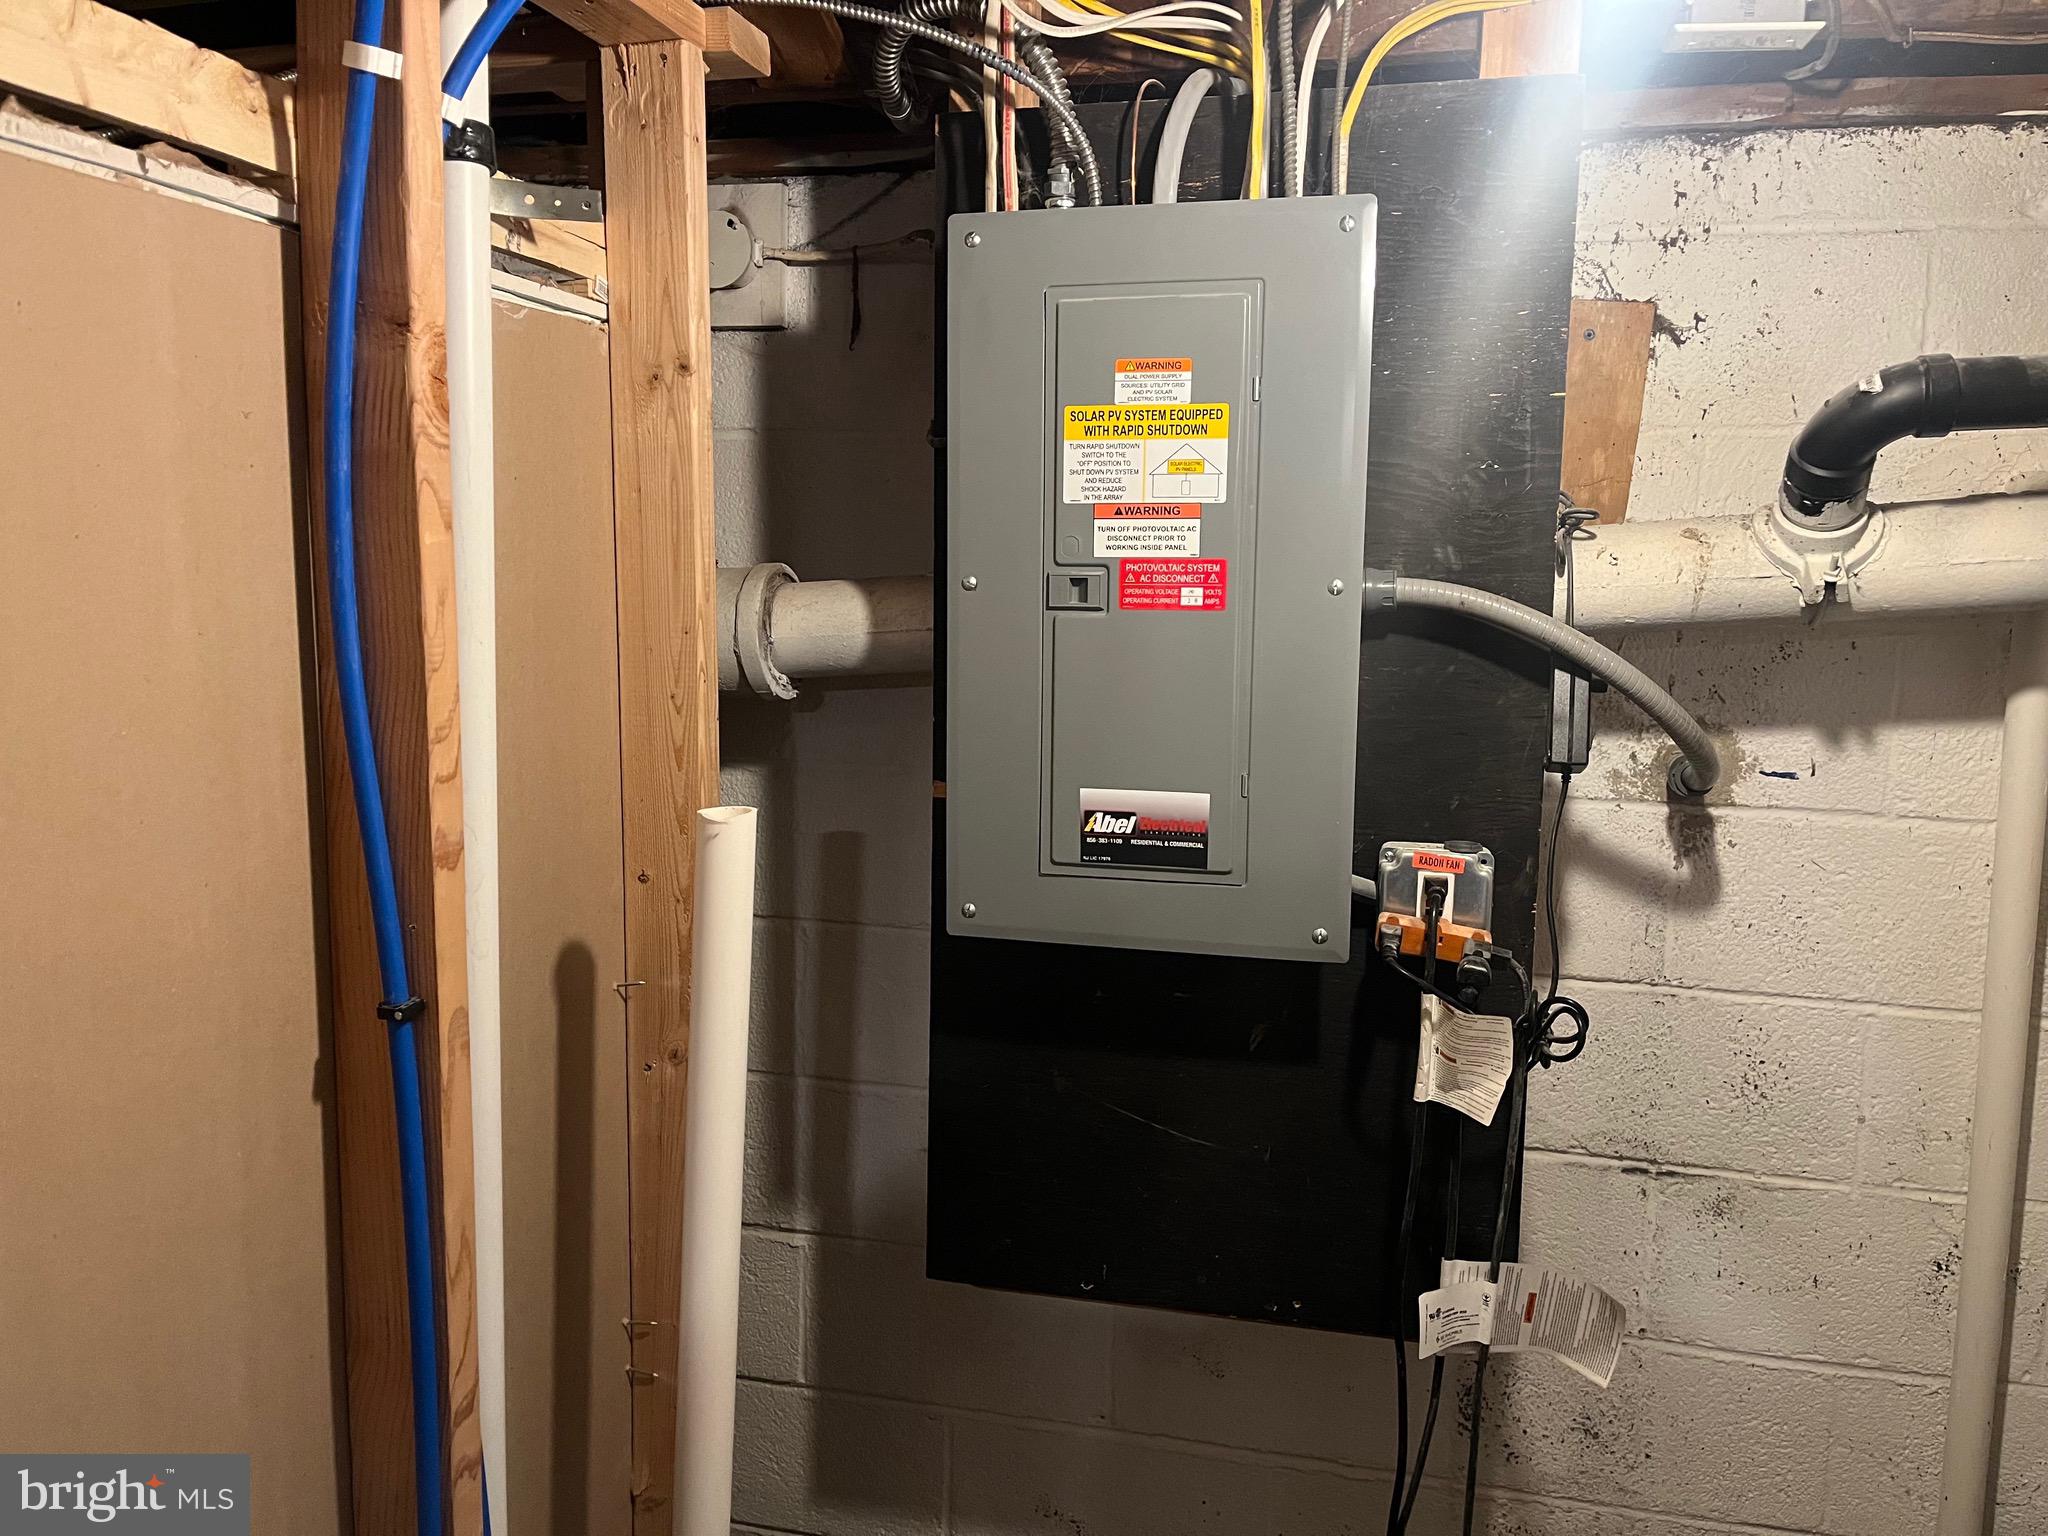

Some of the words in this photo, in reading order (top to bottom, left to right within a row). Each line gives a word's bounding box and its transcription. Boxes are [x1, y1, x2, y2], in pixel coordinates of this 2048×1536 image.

[1135, 361, 1182, 370] WARNING
[1070, 410, 1105, 422] SOLAR
[1108, 410, 1122, 421] PV
[1124, 409, 1167, 421] SYSTEM
[1169, 408, 1224, 421] EQUIPPED
[1084, 425, 1110, 437] WITH
[1112, 424, 1144, 436] RAPID
[1147, 423, 1208, 436] SHUTDOWN
[1124, 506, 1181, 516] WARNING
[1125, 563, 1186, 573] PHOTOVOLTAIC
[1187, 563, 1220, 572] SYSTEM
[1139, 574, 1152, 583] AC
[1152, 574, 1205, 583] DISCONNECT
[1083, 811, 1137, 834] Abel
[1130, 839, 1163, 847] RESIDENTIAL
[1169, 841, 1205, 849] COMMERCIAL
[1418, 856, 1444, 868] RADON
[1445, 858, 1461, 870] FAN
